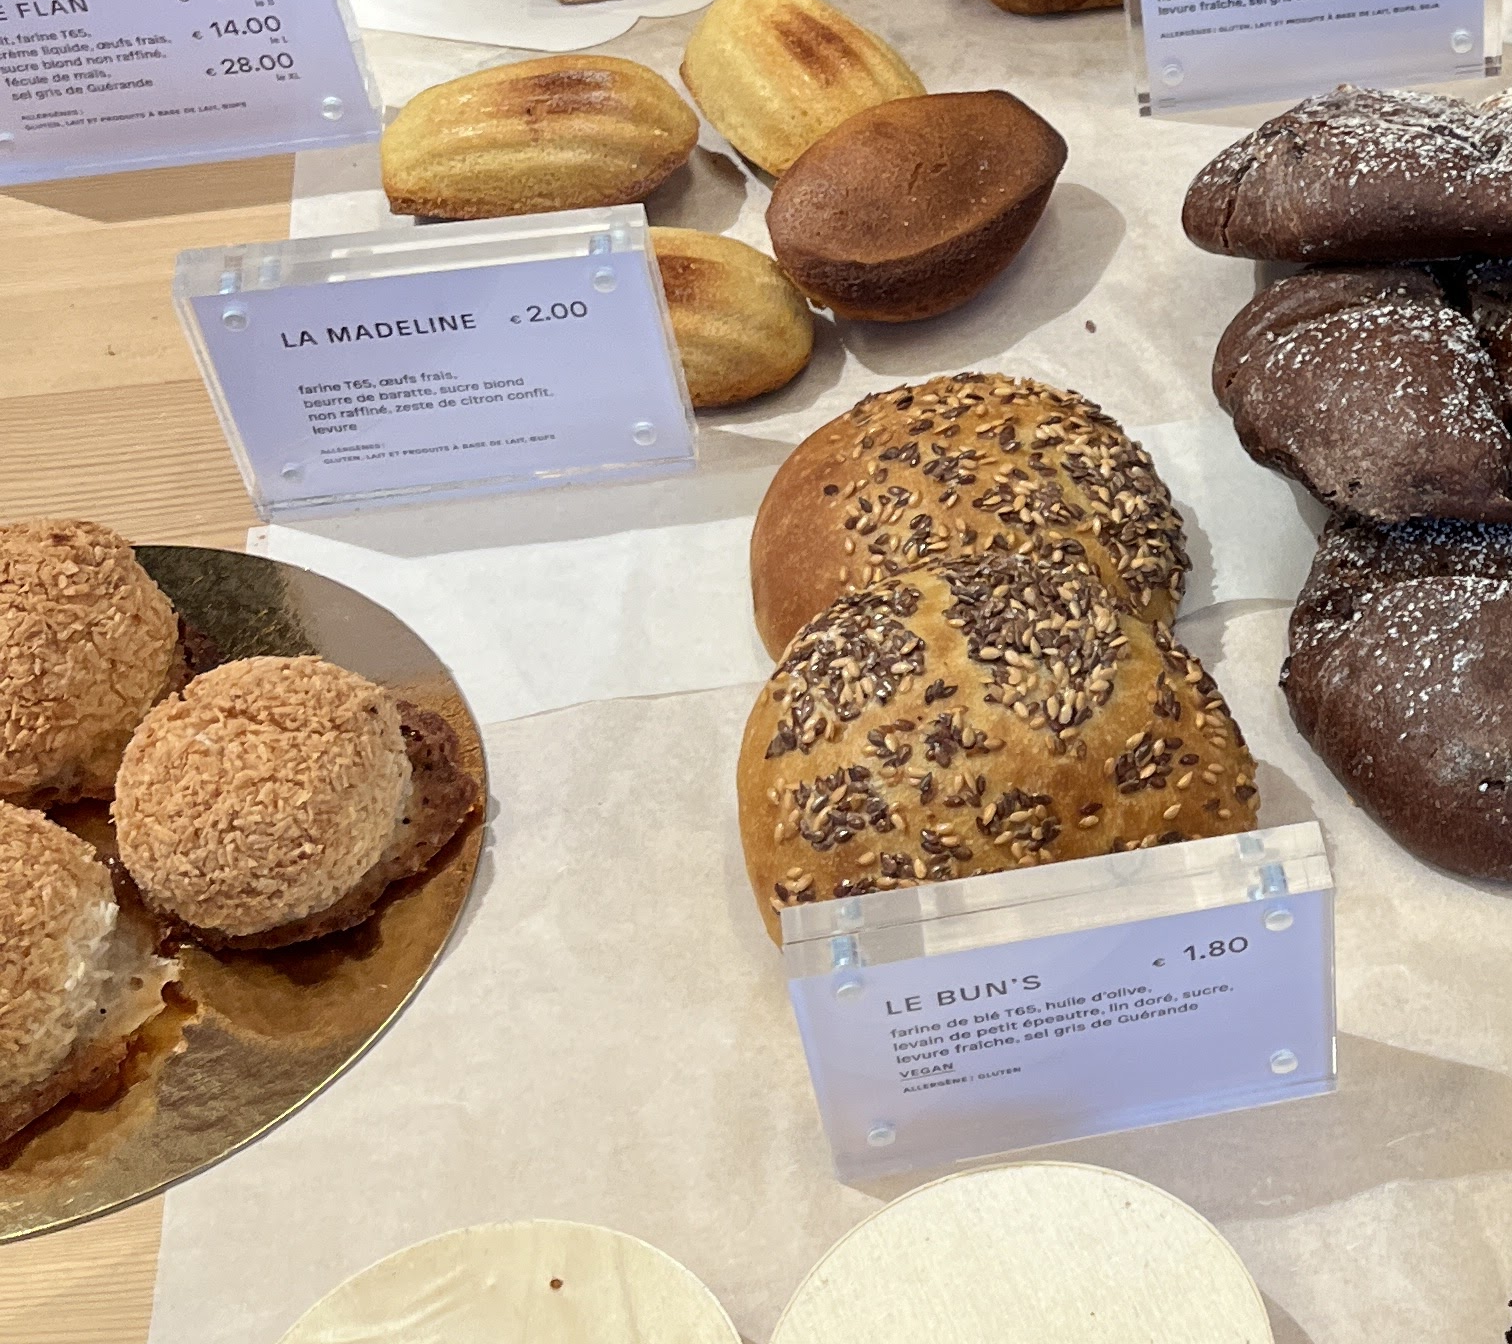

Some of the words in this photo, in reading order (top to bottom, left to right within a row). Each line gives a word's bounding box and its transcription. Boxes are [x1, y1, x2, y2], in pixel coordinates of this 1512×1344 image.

[192, 30, 203, 40] €
[209, 15, 281, 38] 14.00
[206, 67, 217, 76] €
[221, 52, 294, 75] 28.00
[282, 329, 318, 349] LA
[327, 313, 478, 344] MADELINE
[510, 314, 522, 325] €
[526, 300, 589, 323] 2.00
[297, 382, 341, 395] farine
[378, 373, 417, 387] œufs
[302, 396, 353, 409] beurre
[355, 393, 375, 403] de
[438, 382, 480, 394] sucre
[482, 377, 525, 390] blond
[307, 411, 337, 422] non
[394, 401, 434, 413] zeste
[437, 398, 457, 408] de
[459, 393, 504, 406] citron
[311, 423, 358, 435] levure
[885, 995, 924, 1017] LE
[937, 973, 1044, 1008] BUN'S
[1151, 957, 1167, 968] €
[1182, 934, 1250, 963] 1.80
[889, 1022, 941, 1039] farine
[946, 1017, 969, 1028] de
[972, 1010, 1000, 1024] blé
[1044, 996, 1086, 1011] huile
[892, 1035, 944, 1052] levain
[948, 1030, 971, 1042] de
[975, 1021, 1018, 1039] petit
[1108, 1002, 1129, 1013] lin
[895, 1048, 950, 1064] levure
[1023, 1027, 1049, 1041] sel
[1053, 1023, 1086, 1038] gris
[1090, 1018, 1112, 1029] de
[1117, 1002, 1199, 1024] Guérande
[898, 1061, 954, 1080] VEGAN
